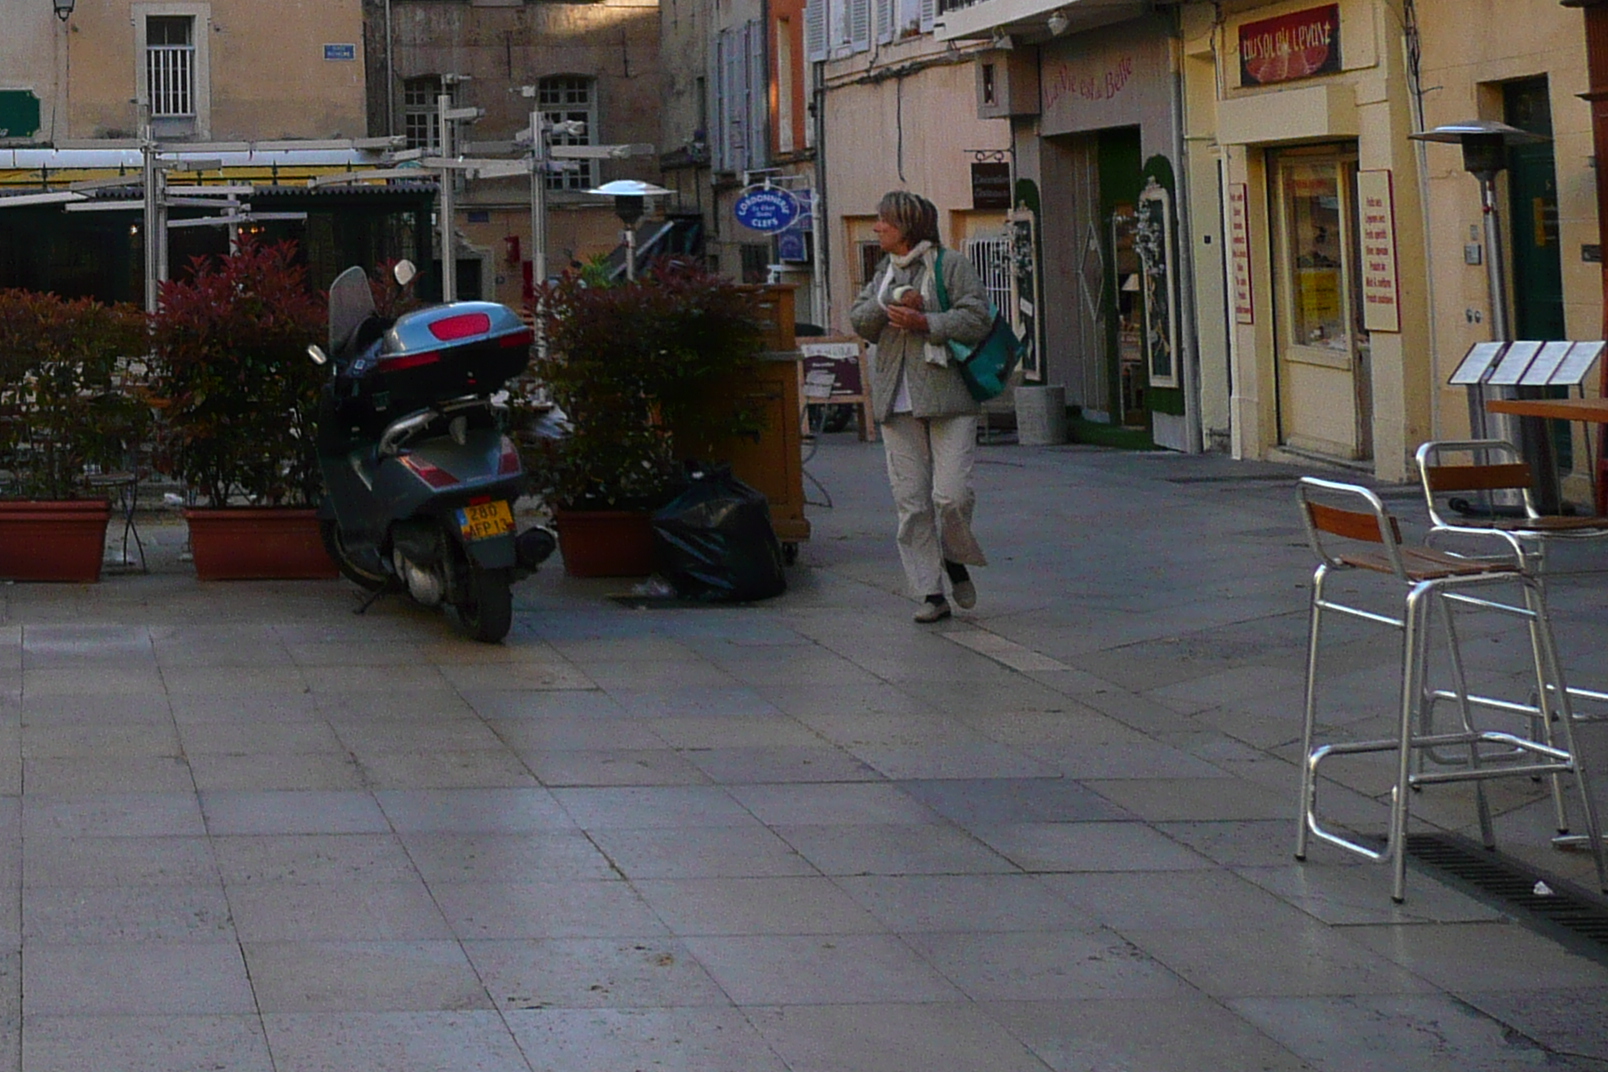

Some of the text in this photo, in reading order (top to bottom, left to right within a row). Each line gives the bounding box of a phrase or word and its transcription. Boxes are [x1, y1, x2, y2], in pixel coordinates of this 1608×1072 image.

[751, 217, 779, 227] CLEFS
[469, 503, 497, 521] 280
[469, 517, 508, 537] AFP 13
